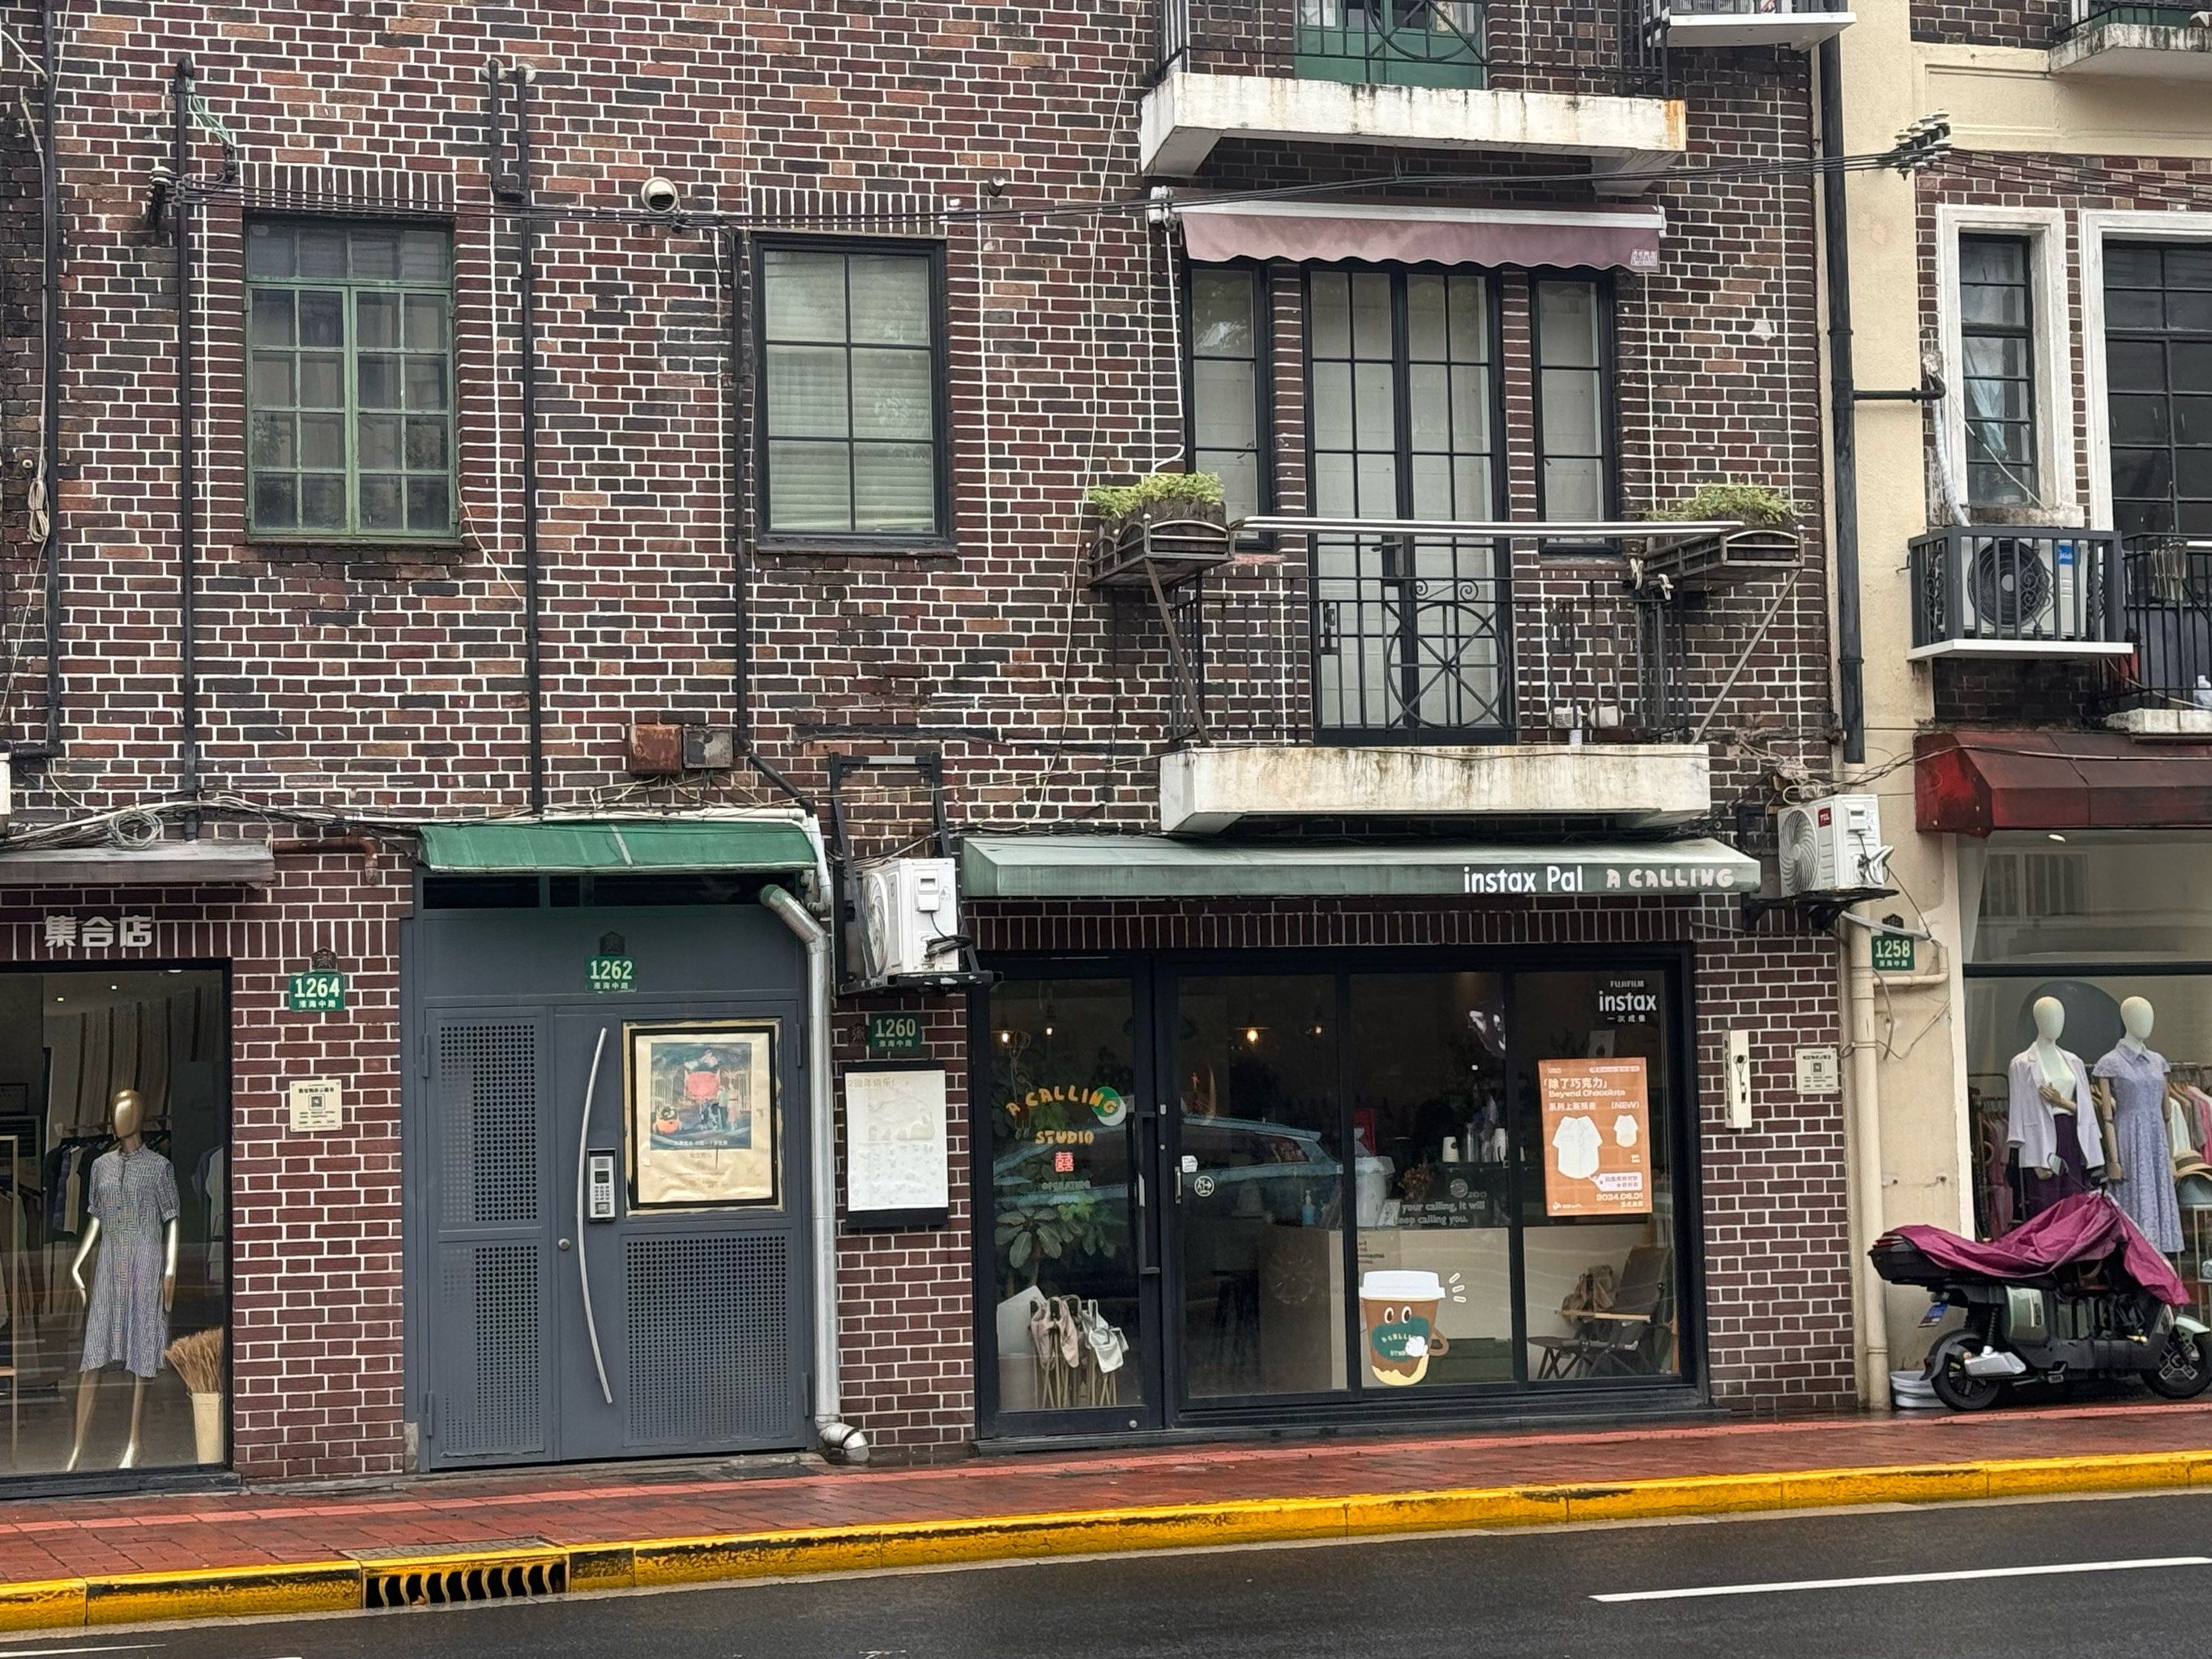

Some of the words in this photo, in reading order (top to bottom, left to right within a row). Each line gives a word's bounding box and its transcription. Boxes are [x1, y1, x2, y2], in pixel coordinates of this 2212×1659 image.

[1463, 866, 1536, 892] instax
[1547, 866, 1583, 892] Pal
[1606, 869, 1621, 889] A
[1628, 868, 1734, 888] CALLING
[45, 915, 152, 948] 集合店
[1875, 940, 1911, 957] 1258
[590, 960, 632, 979] 1262
[294, 977, 340, 997] 1264
[1599, 990, 1657, 1012] instax
[875, 1018, 916, 1037] 1260
[1006, 1102, 1021, 1116] A
[1025, 1085, 1118, 1114] CALLING
[1036, 1131, 1094, 1145] STUDIO
[1402, 1203, 1423, 1214] your
[1468, 1201, 1486, 1210] will
[1417, 1215, 1447, 1226] calling
